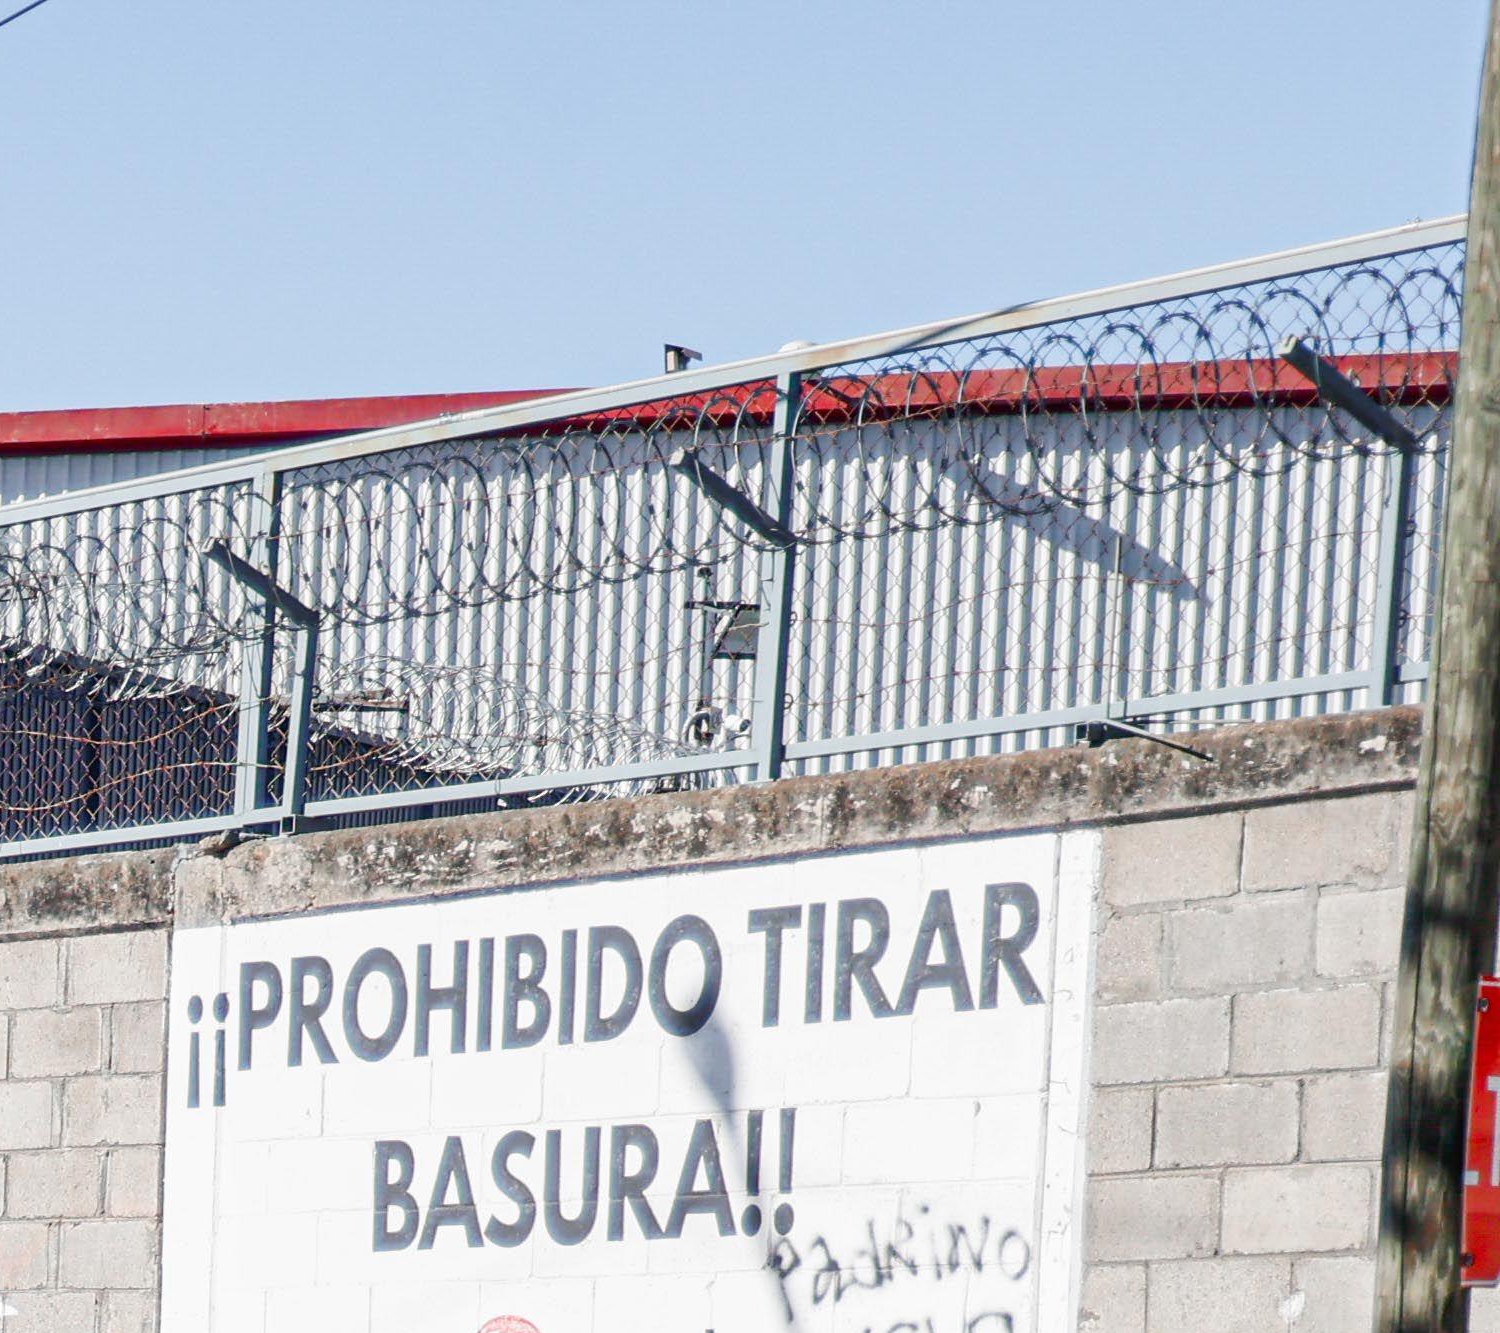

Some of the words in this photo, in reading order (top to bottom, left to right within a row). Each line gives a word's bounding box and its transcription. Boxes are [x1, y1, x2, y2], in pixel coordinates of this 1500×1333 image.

[186, 912, 724, 1109] ¡¡PROHIBIDO
[748, 880, 1045, 1029] TIRAR
[372, 1106, 798, 1253] BASURA!!
